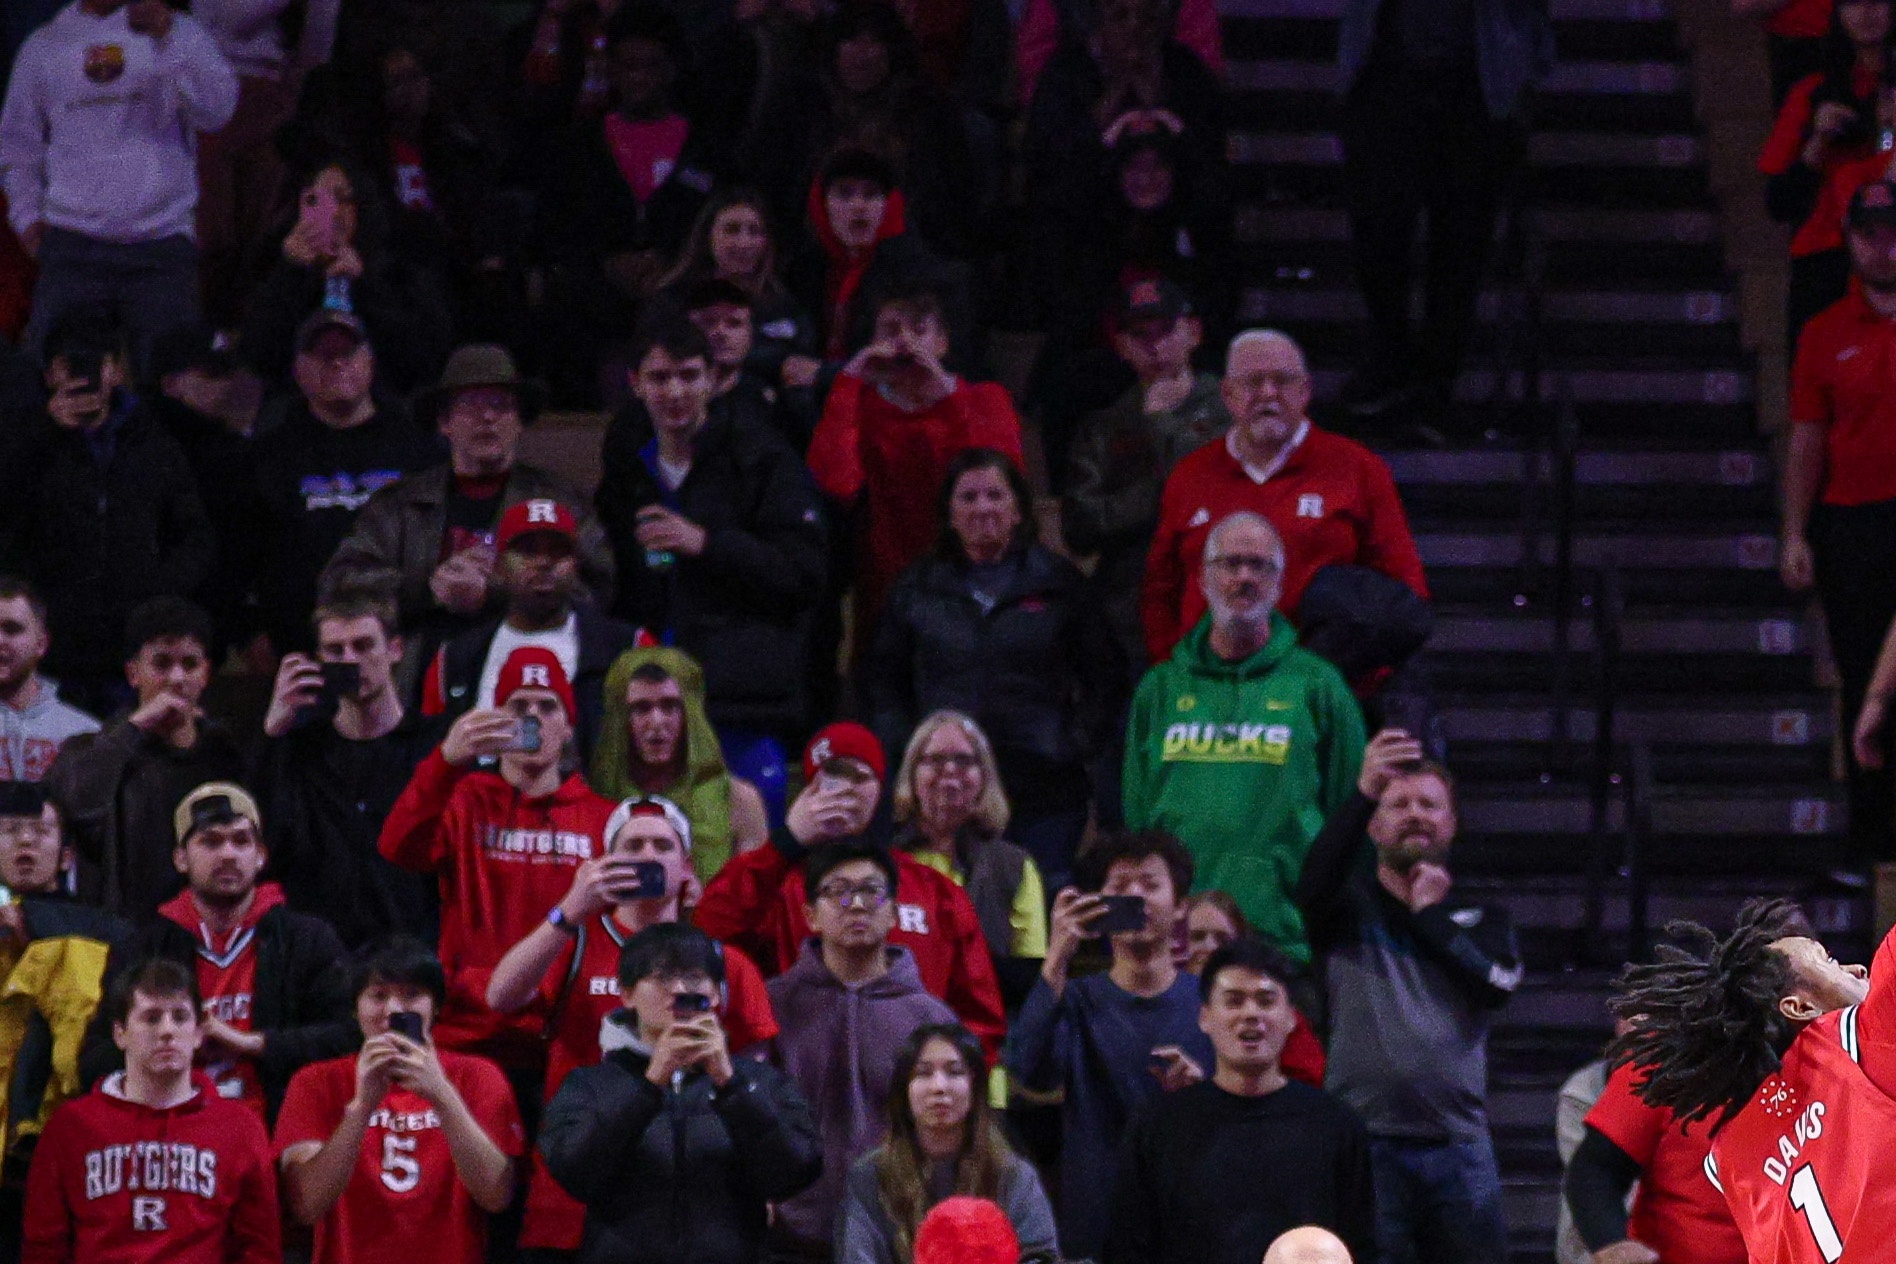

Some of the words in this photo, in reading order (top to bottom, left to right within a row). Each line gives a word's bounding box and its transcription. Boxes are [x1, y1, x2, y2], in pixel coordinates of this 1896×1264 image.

[527, 498, 557, 524] R
[521, 663, 551, 688] R
[1164, 721, 1292, 760] DUCKS
[897, 904, 929, 935] R
[1769, 1087, 1788, 1110] 76
[85, 1144, 217, 1200] RUTGERS
[380, 1133, 420, 1193] 5
[131, 1194, 168, 1232] R
[1788, 1161, 1842, 1264] 1
